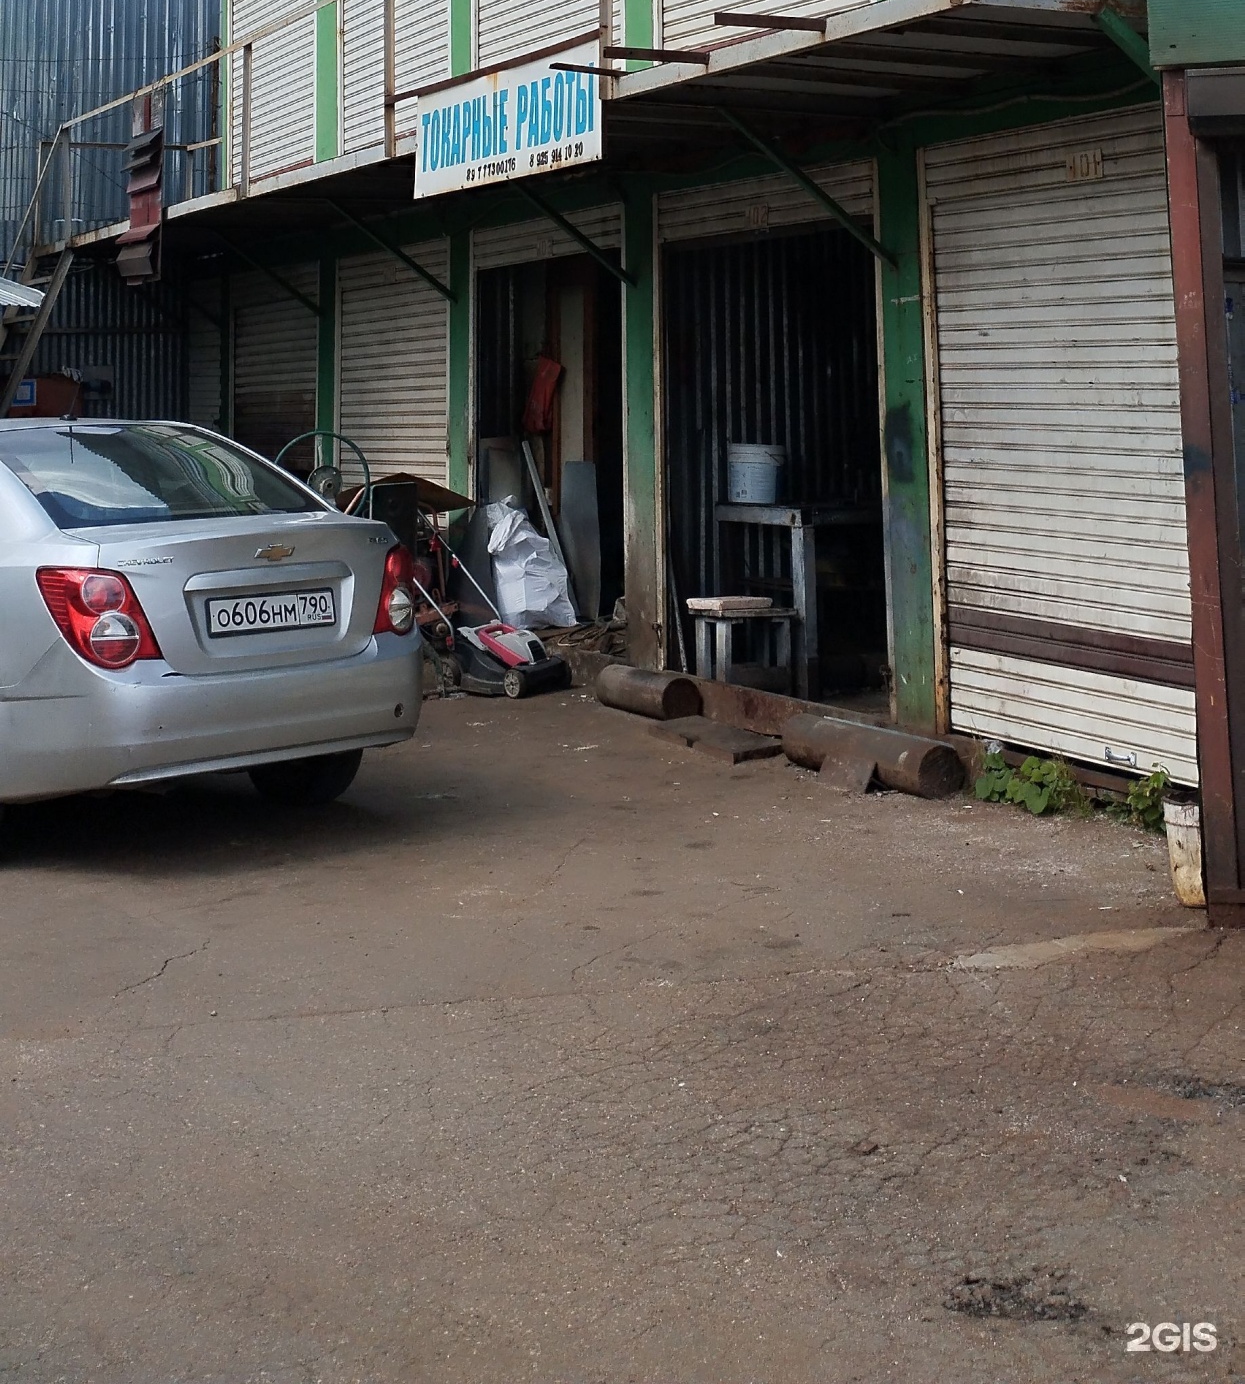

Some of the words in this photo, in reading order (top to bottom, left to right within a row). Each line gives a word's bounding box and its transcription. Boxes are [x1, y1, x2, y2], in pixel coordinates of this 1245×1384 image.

[422, 89, 509, 173] ТОКАРНЫЕ
[515, 62, 595, 151] РАБОТЫ
[565, 143, 572, 161] 10
[574, 141, 583, 158] 20
[117, 556, 174, 567] CHEVROLET
[299, 596, 328, 615] 790
